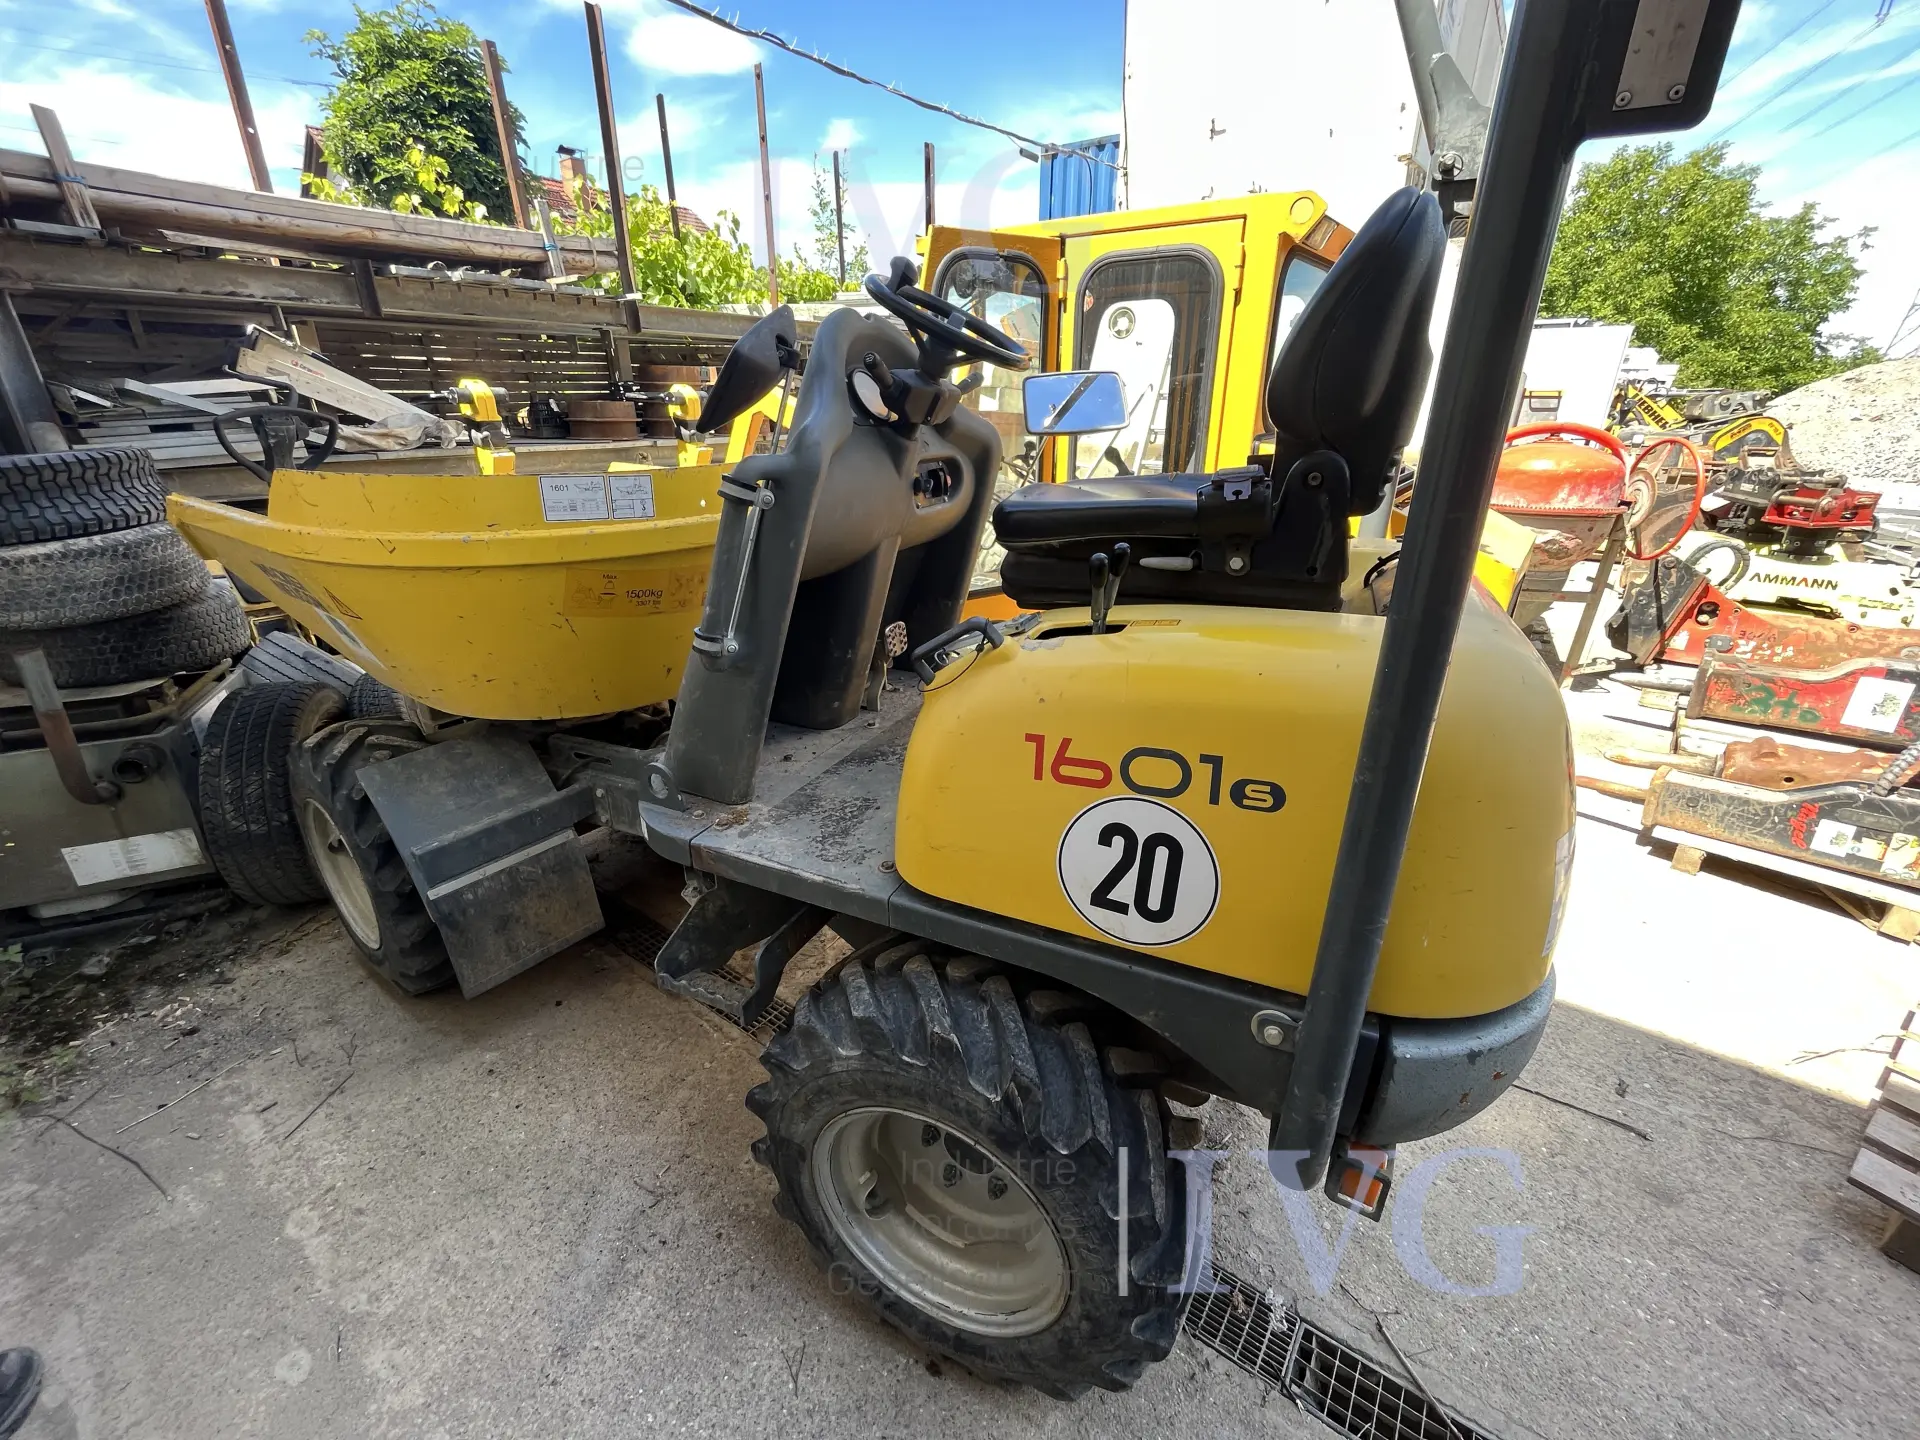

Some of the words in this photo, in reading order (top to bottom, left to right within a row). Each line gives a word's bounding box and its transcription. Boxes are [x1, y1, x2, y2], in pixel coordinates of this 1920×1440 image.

[549, 484, 569, 492] 1601
[1748, 572, 1839, 591] AMMANN
[625, 588, 664, 600] 1500kg
[1088, 821, 1185, 924] 20
